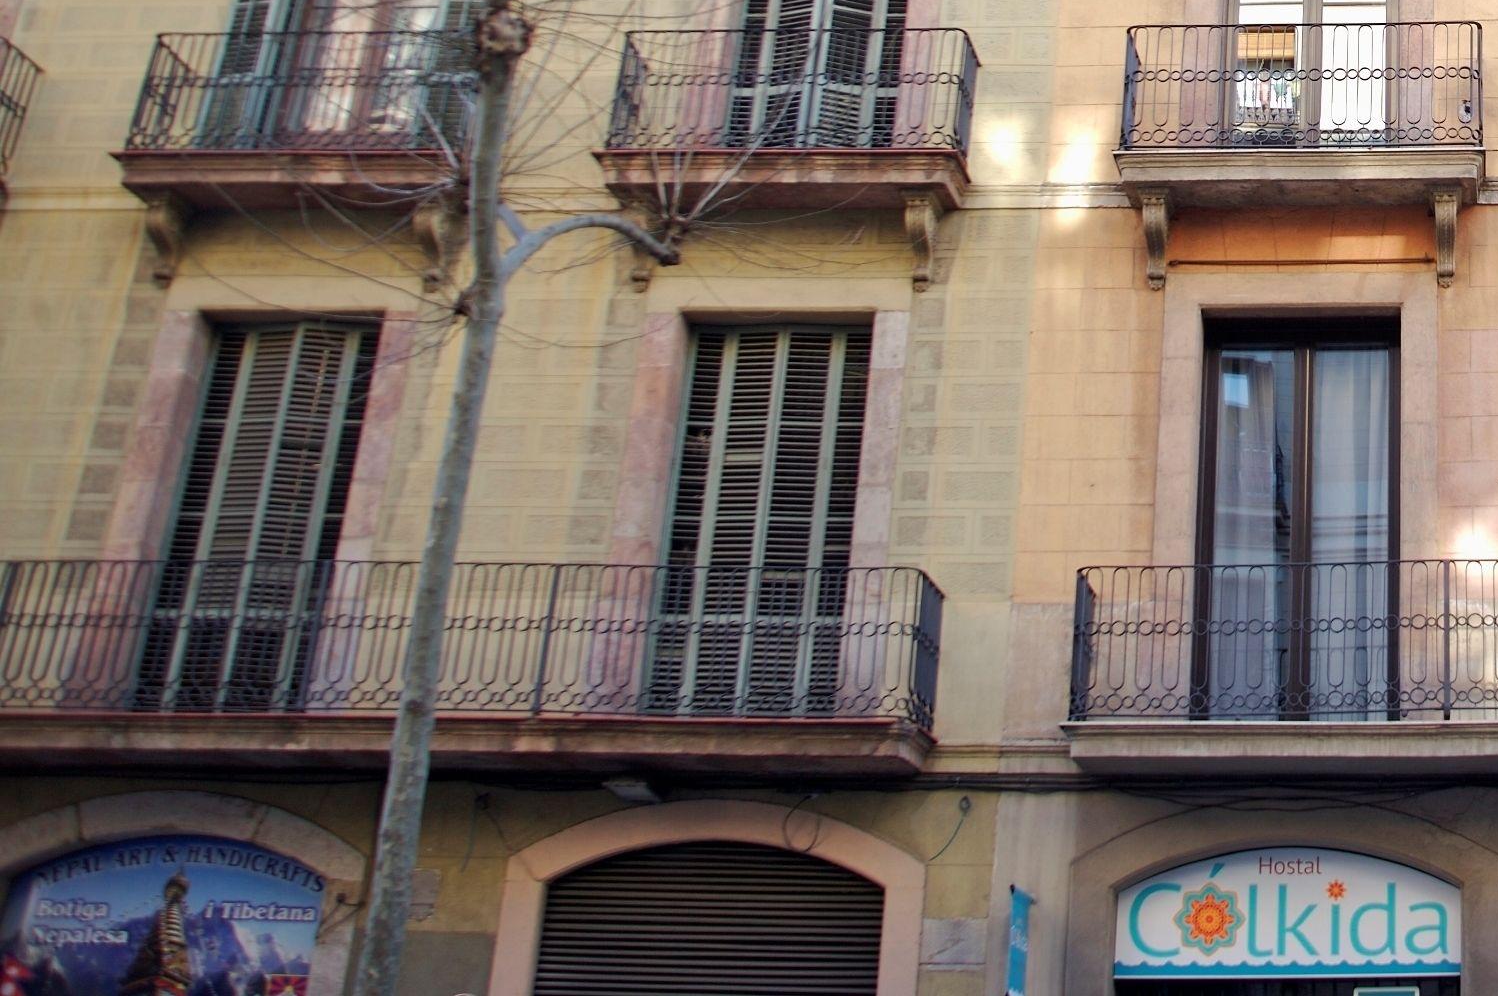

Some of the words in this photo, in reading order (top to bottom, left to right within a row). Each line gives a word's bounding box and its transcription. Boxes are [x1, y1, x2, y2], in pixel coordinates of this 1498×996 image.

[36, 857, 103, 886] NEPAL
[114, 848, 155, 867] ART
[161, 847, 175, 863] &
[187, 845, 325, 893] HANDICRAFTS
[1259, 857, 1322, 875] Hostal
[37, 899, 108, 921] Botiga
[205, 900, 215, 919] i
[222, 902, 316, 921] Tibetana
[32, 926, 128, 947] Nepalesa
